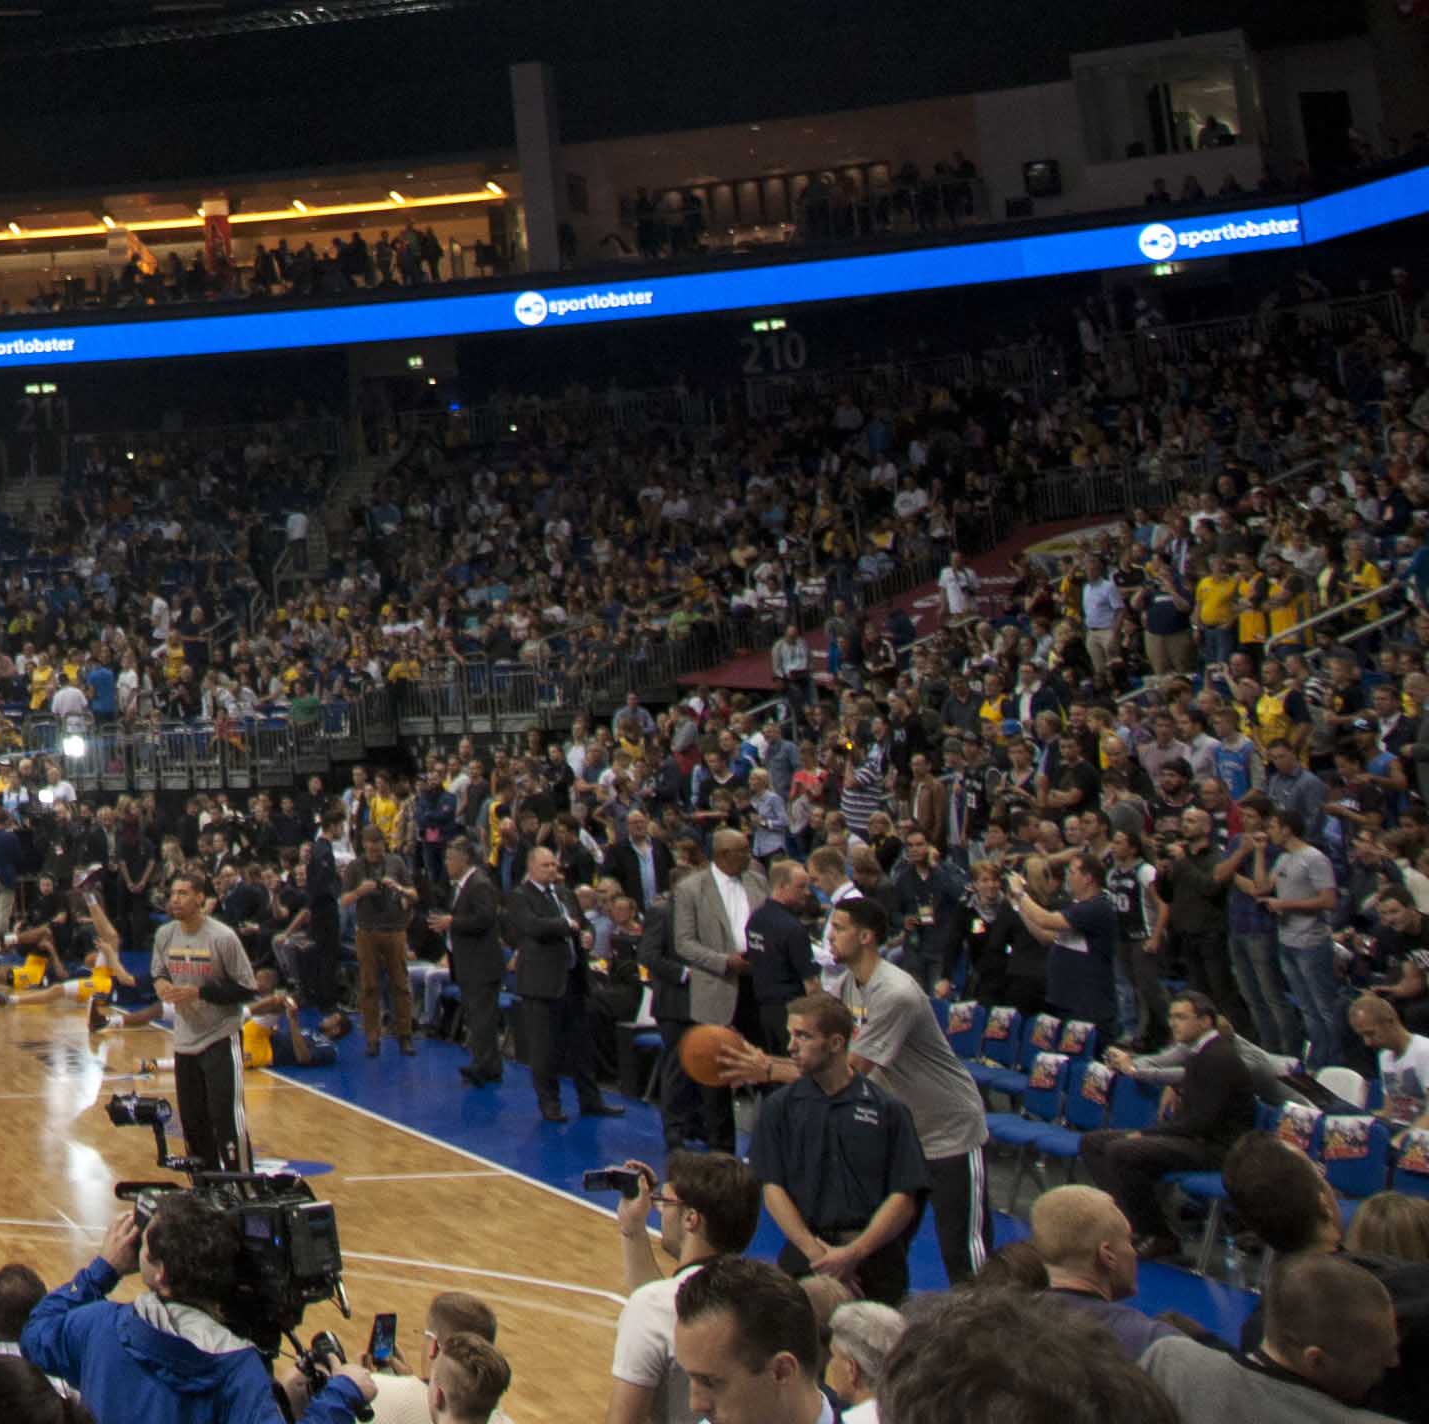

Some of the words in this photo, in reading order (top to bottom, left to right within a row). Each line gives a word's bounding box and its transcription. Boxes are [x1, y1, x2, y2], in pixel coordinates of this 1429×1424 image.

[1178, 218, 1297, 247] sportlobster
[549, 290, 652, 315] sportlobster
[741, 331, 807, 374] 210
